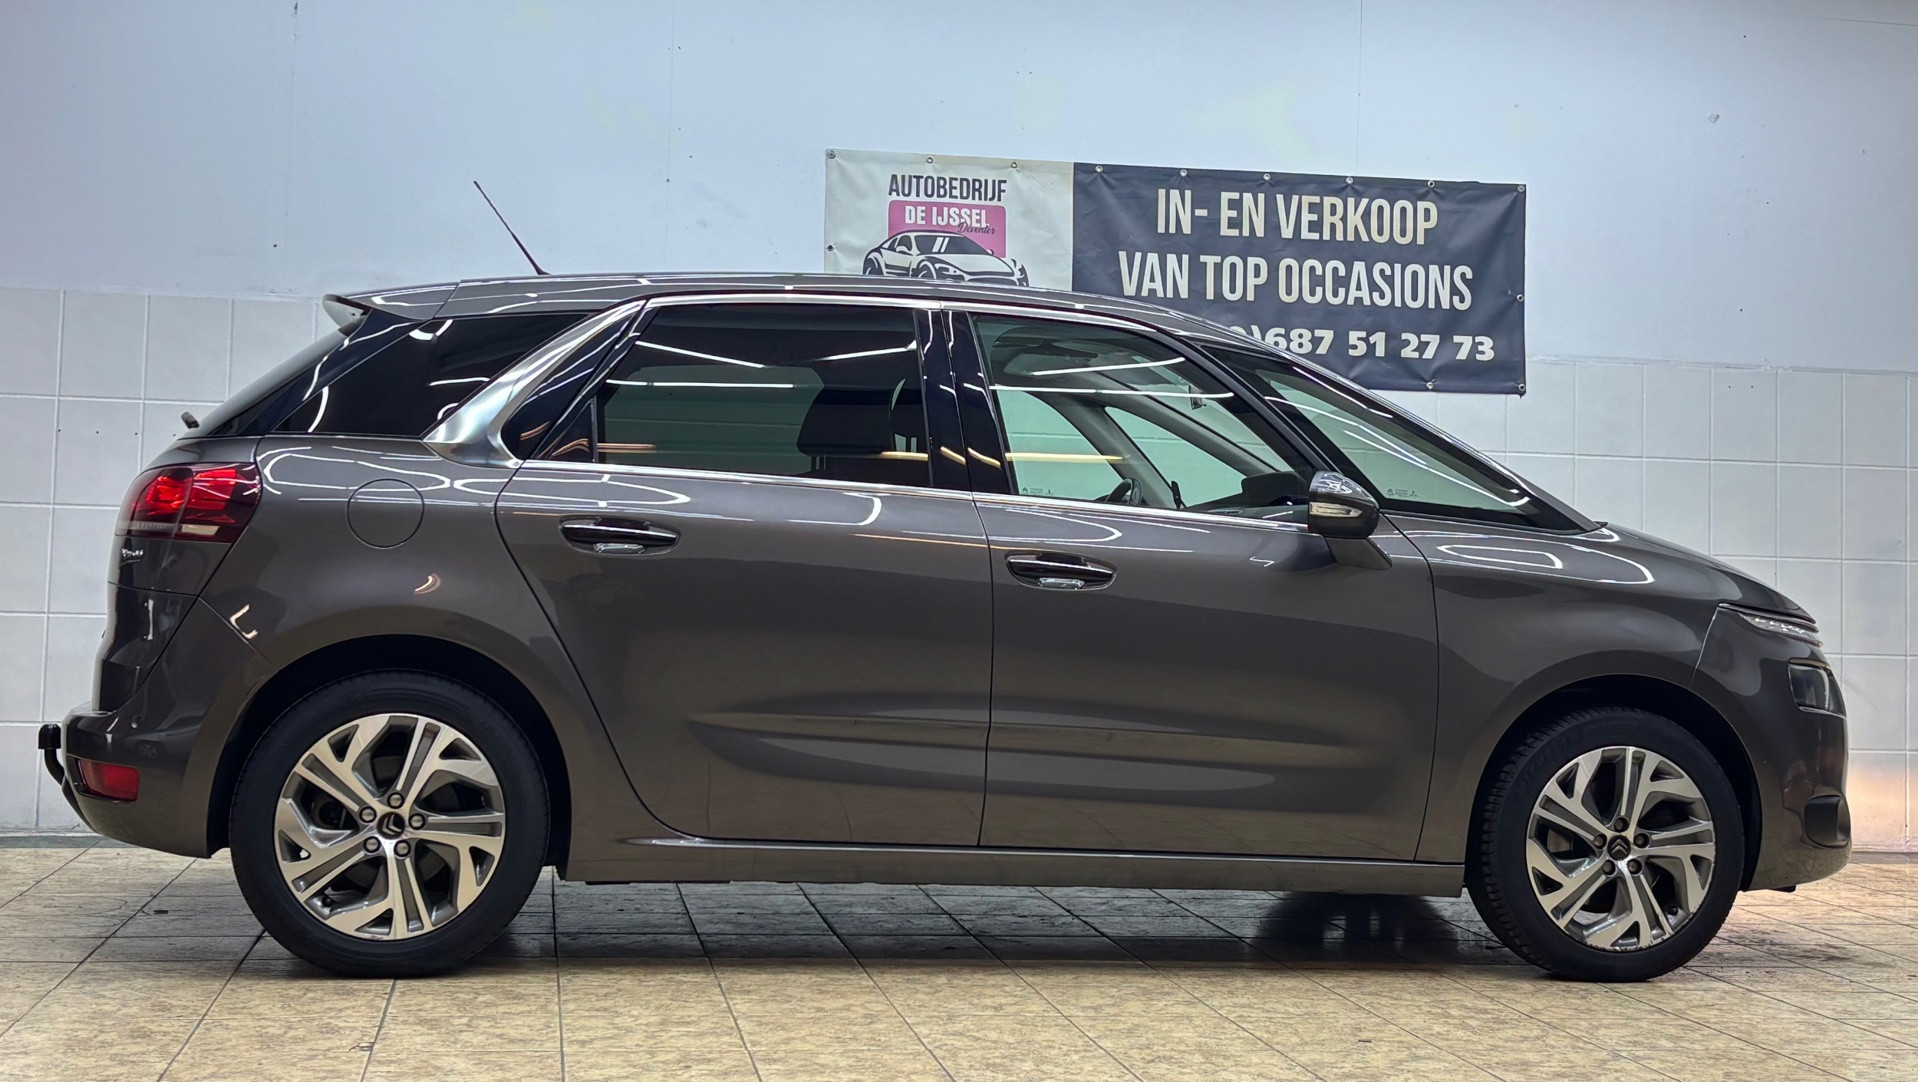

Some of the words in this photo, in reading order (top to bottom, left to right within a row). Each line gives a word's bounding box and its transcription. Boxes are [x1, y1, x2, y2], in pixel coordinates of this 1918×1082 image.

[888, 174, 1007, 202] AUTOBEDRIJF
[905, 205, 926, 225] DE
[932, 206, 989, 229] IJSSEL
[1157, 188, 1208, 234] IN-
[1219, 192, 1265, 238] EN
[1276, 194, 1438, 245] VERKOOP
[1118, 250, 1189, 299] VAN
[1200, 254, 1268, 302] TOP
[1278, 258, 1473, 311] OCCASIONS
[1229, 325, 1334, 354] 687
[1348, 330, 1386, 358] 51
[1400, 333, 1440, 360] 27
[1453, 335, 1495, 361] 73
